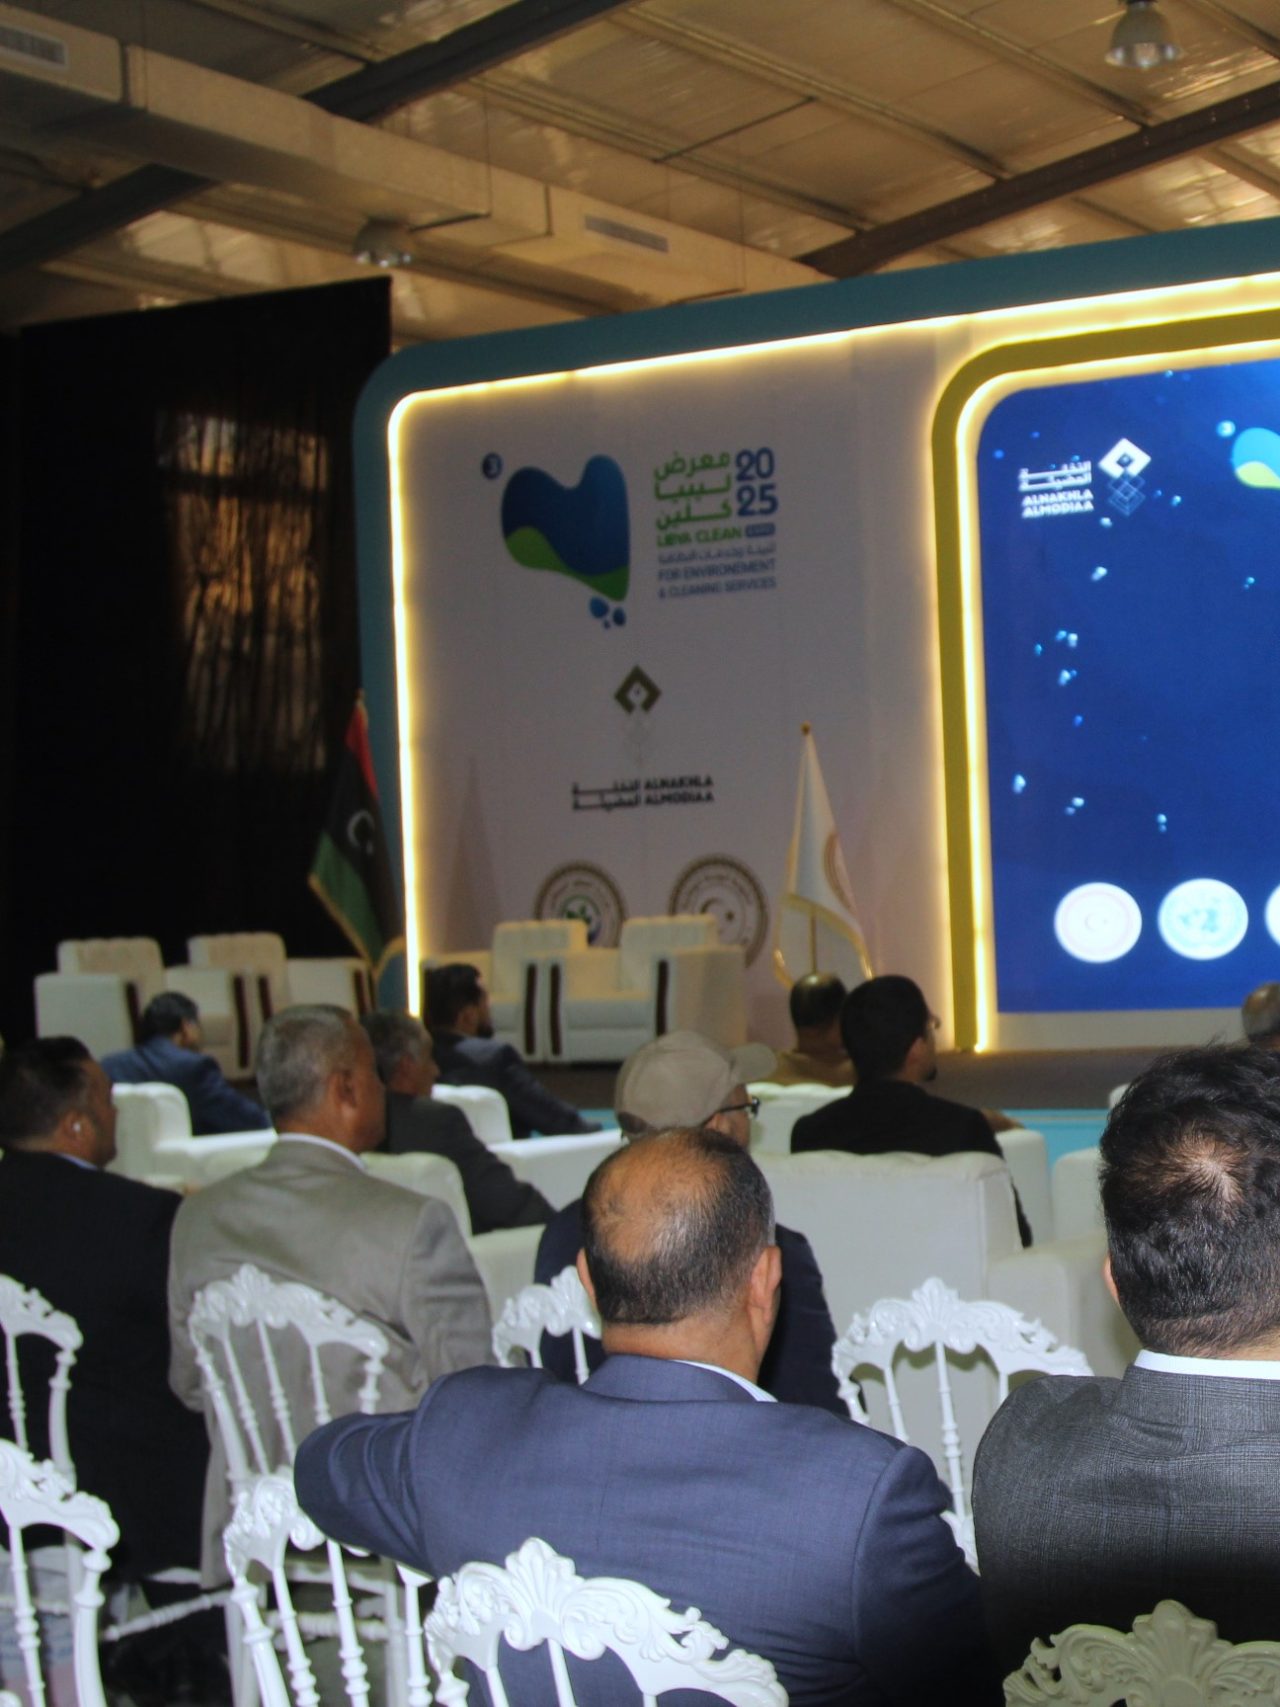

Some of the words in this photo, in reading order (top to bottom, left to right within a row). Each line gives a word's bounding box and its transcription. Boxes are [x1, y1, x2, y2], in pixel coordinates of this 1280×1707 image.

[655, 452, 731, 480] معرض
[735, 447, 775, 481] 20
[737, 483, 779, 516] 25
[696, 527, 741, 543] CLEAN
